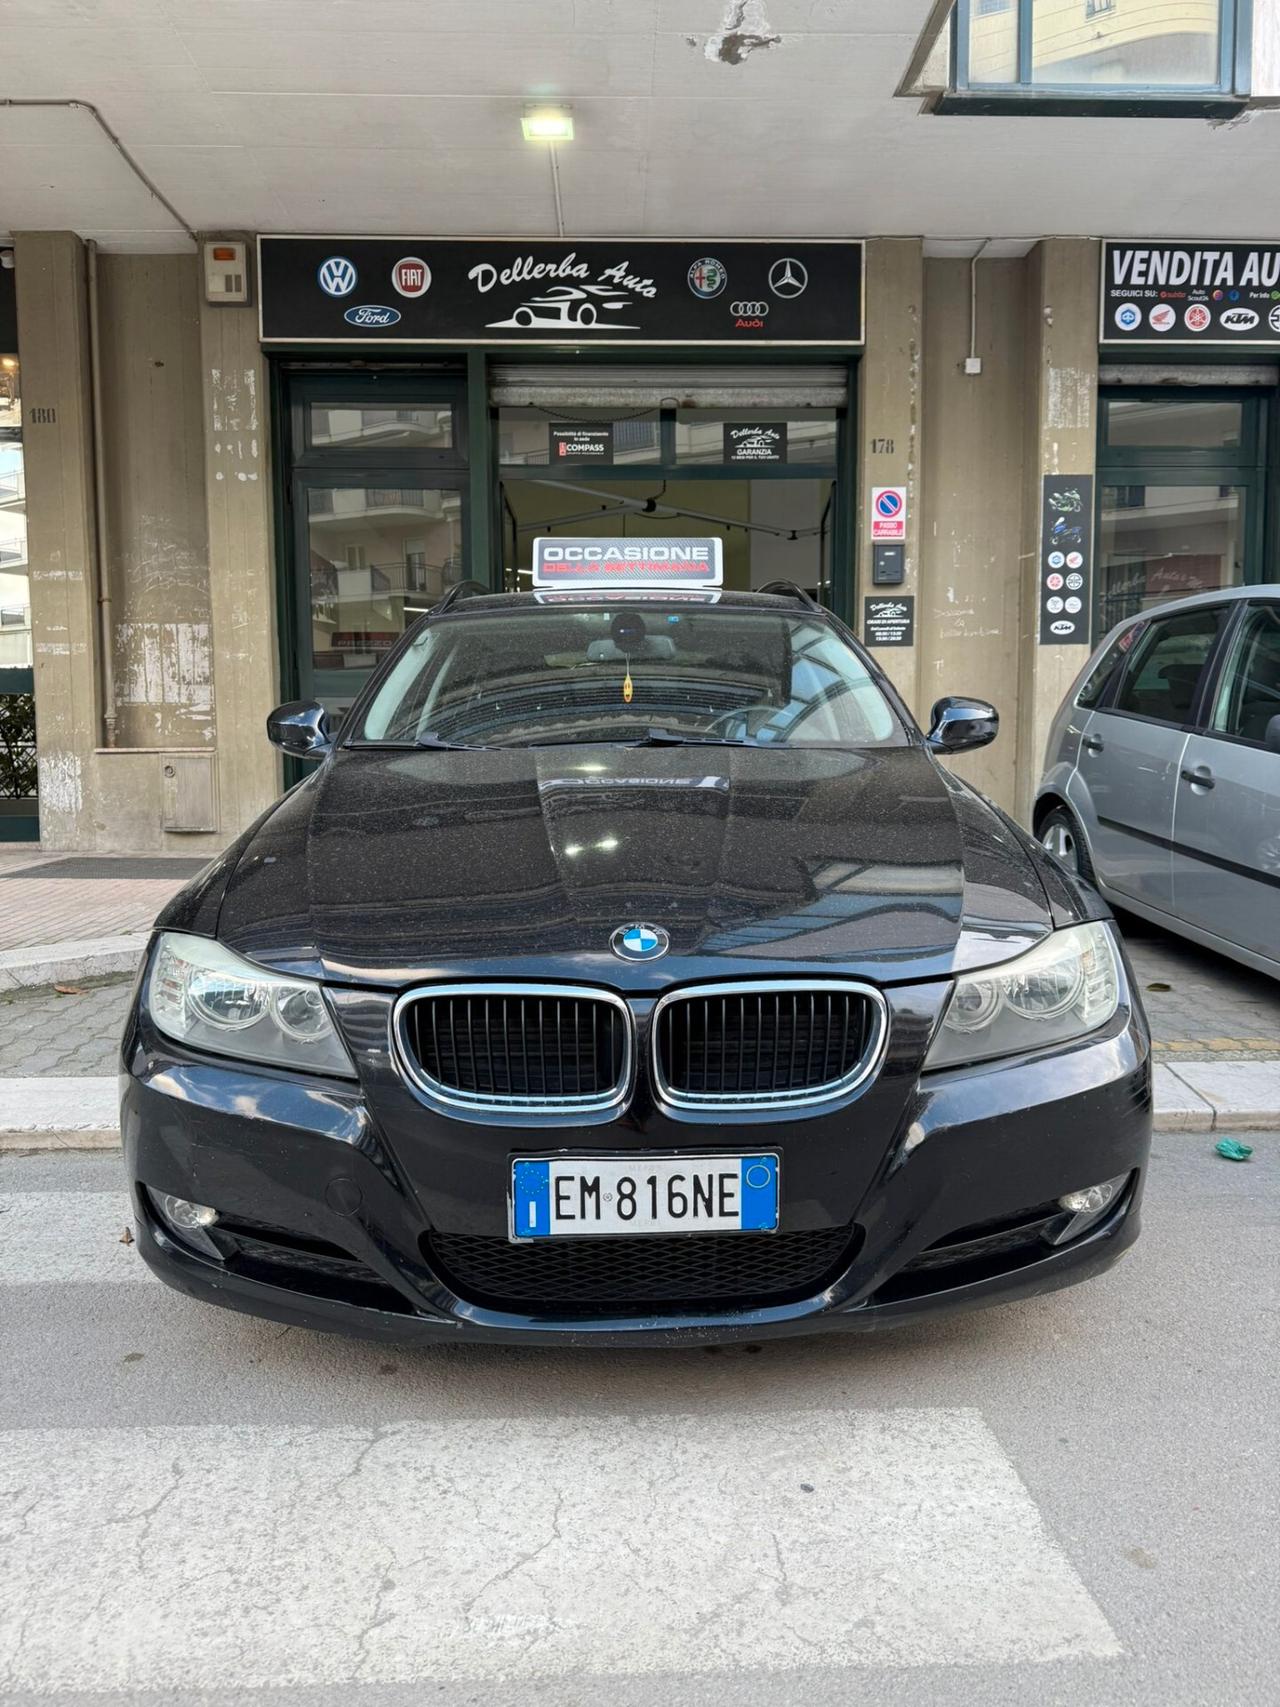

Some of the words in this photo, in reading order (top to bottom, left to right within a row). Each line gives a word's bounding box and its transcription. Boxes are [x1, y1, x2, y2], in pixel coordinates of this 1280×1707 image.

[468, 252, 590, 293] Dellerba
[598, 260, 657, 298] Auto
[1112, 250, 1234, 286] VENDITA
[401, 268, 423, 286] FIAT
[1110, 289, 1143, 298] SEGUICI
[1144, 290, 1158, 298] SU:
[354, 308, 390, 324] Ford
[735, 319, 764, 328] Audi
[1224, 312, 1256, 325] KTM
[566, 443, 604, 451] COMPASS
[870, 438, 895, 454] 178
[543, 546, 709, 561] OCCASIONE
[555, 1175, 601, 1220] EM
[616, 1173, 740, 1221] 816NE
